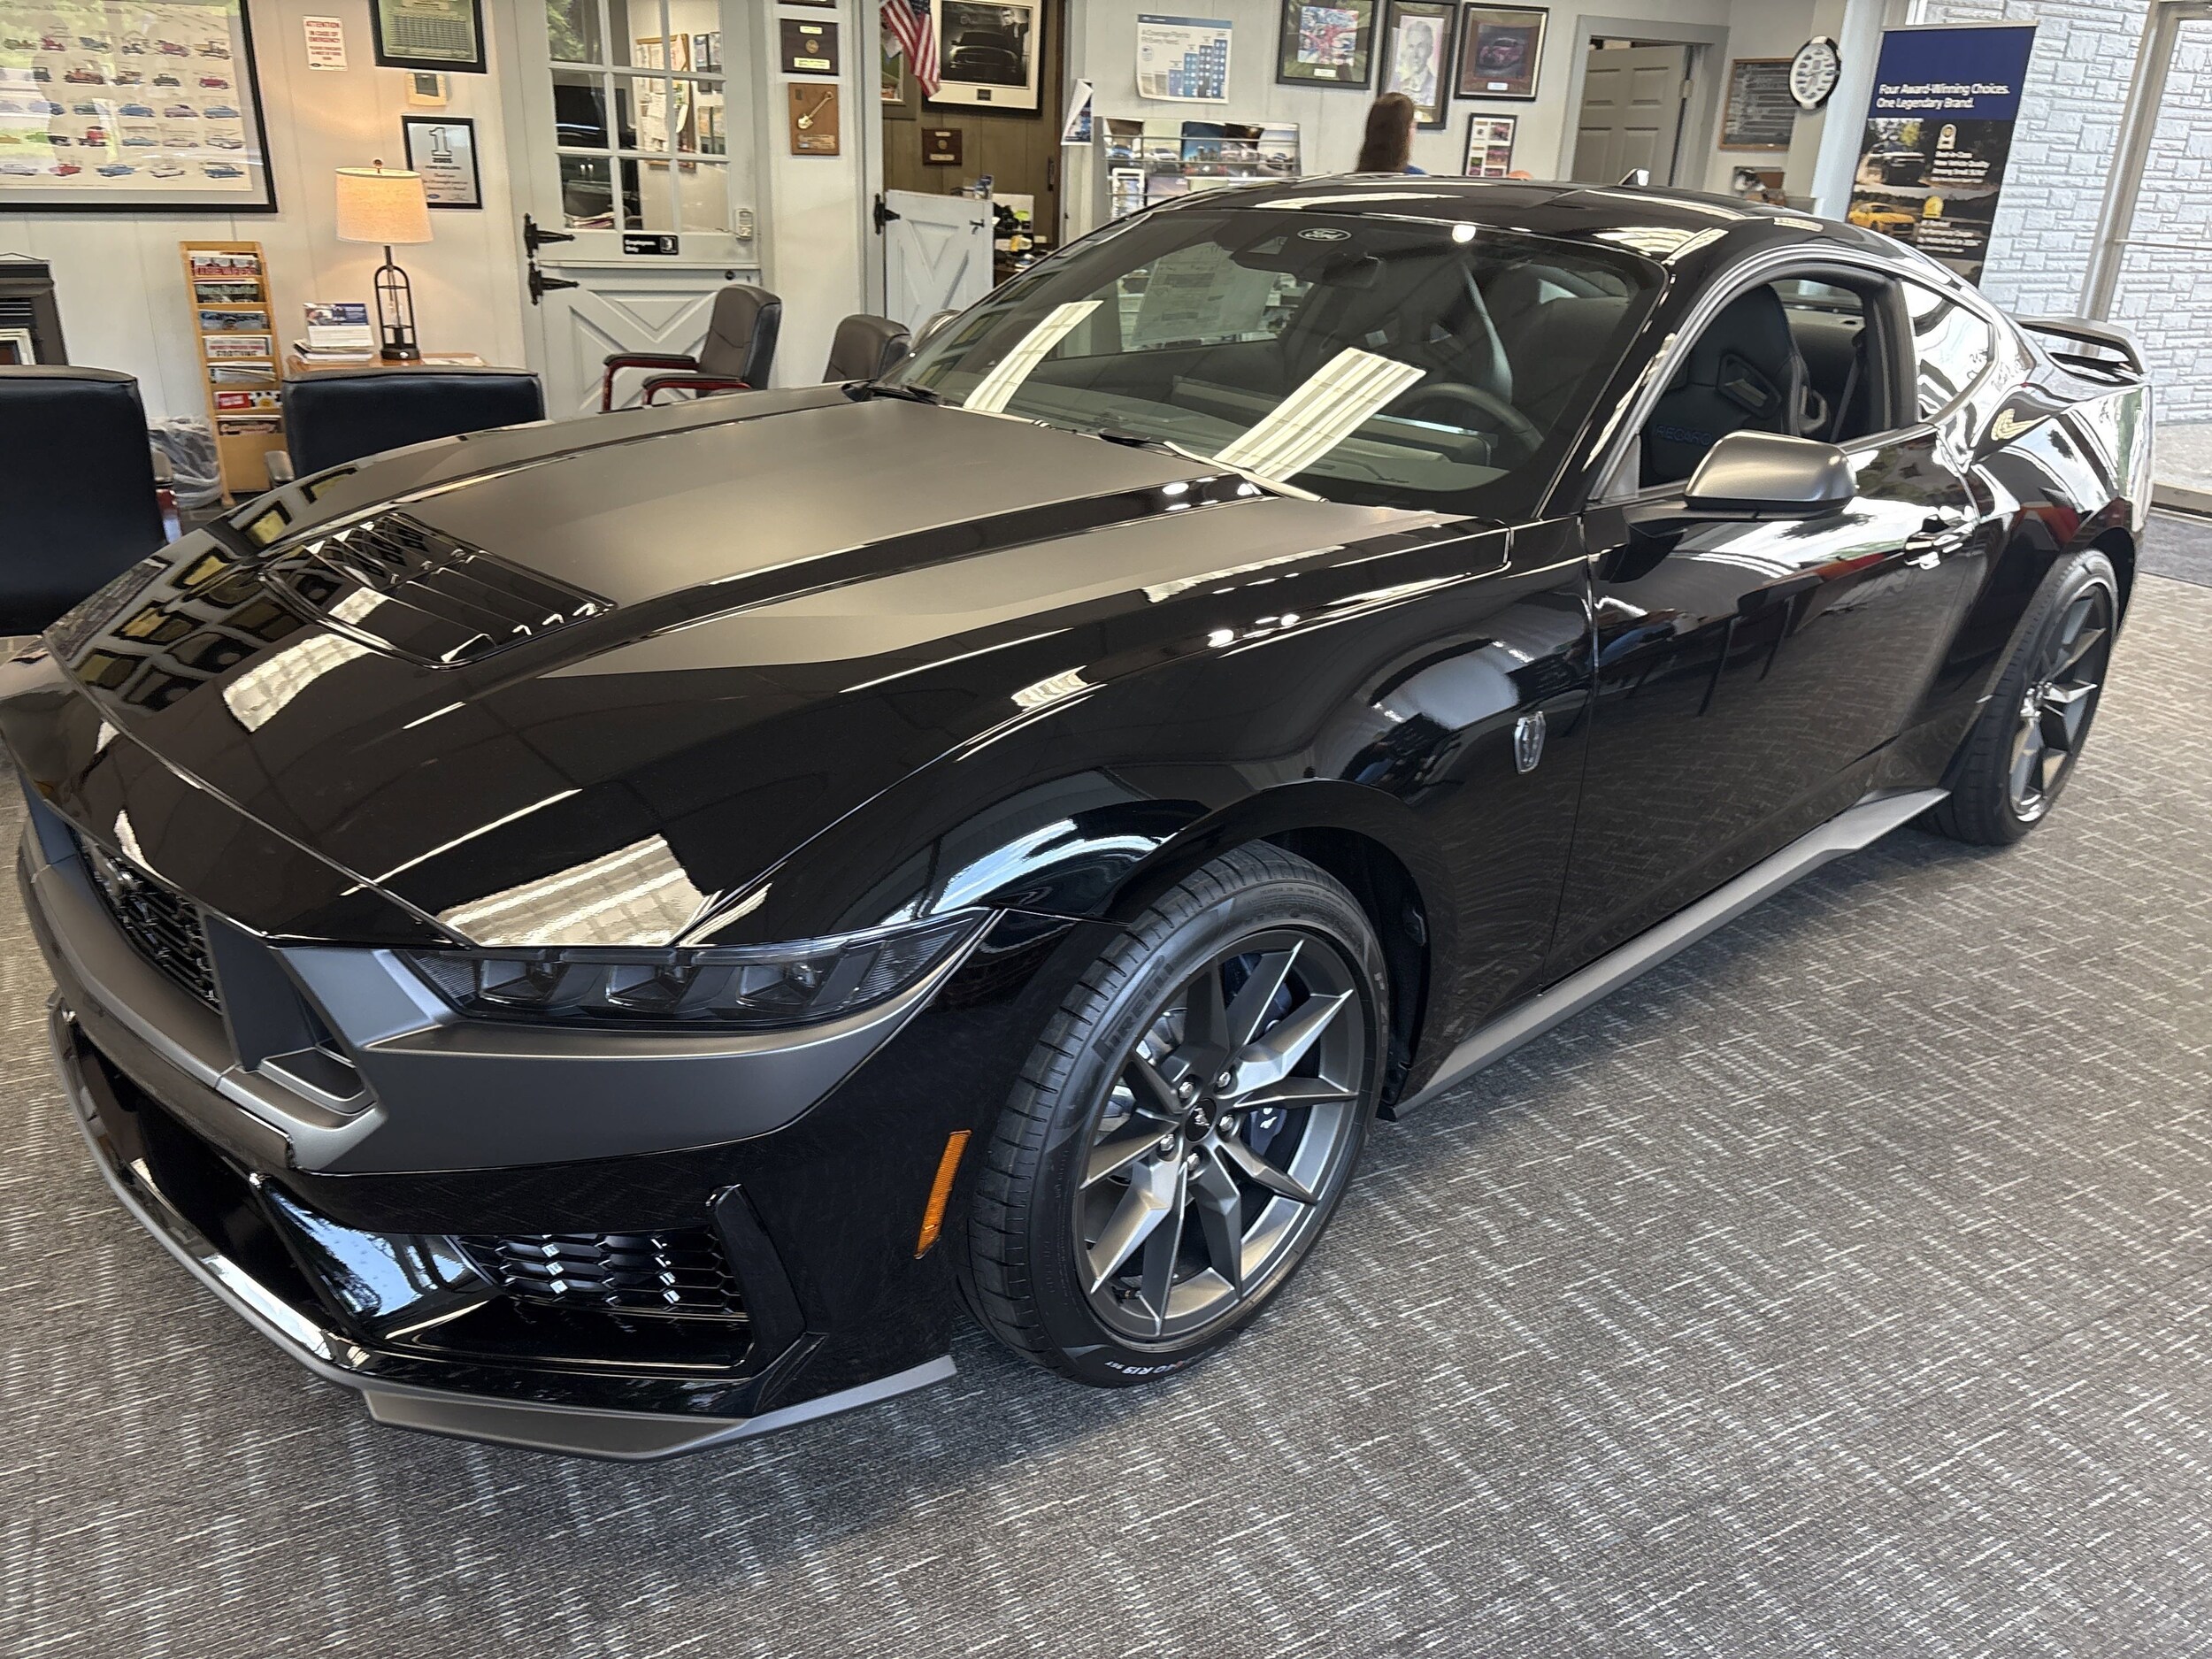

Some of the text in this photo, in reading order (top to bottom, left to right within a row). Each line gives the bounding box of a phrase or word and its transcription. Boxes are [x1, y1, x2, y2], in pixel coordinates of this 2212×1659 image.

[1879, 83, 1901, 95] Four
[1901, 83, 1970, 96] Award-Winning
[1876, 97, 1894, 108] One
[1895, 97, 1943, 110] Legendary
